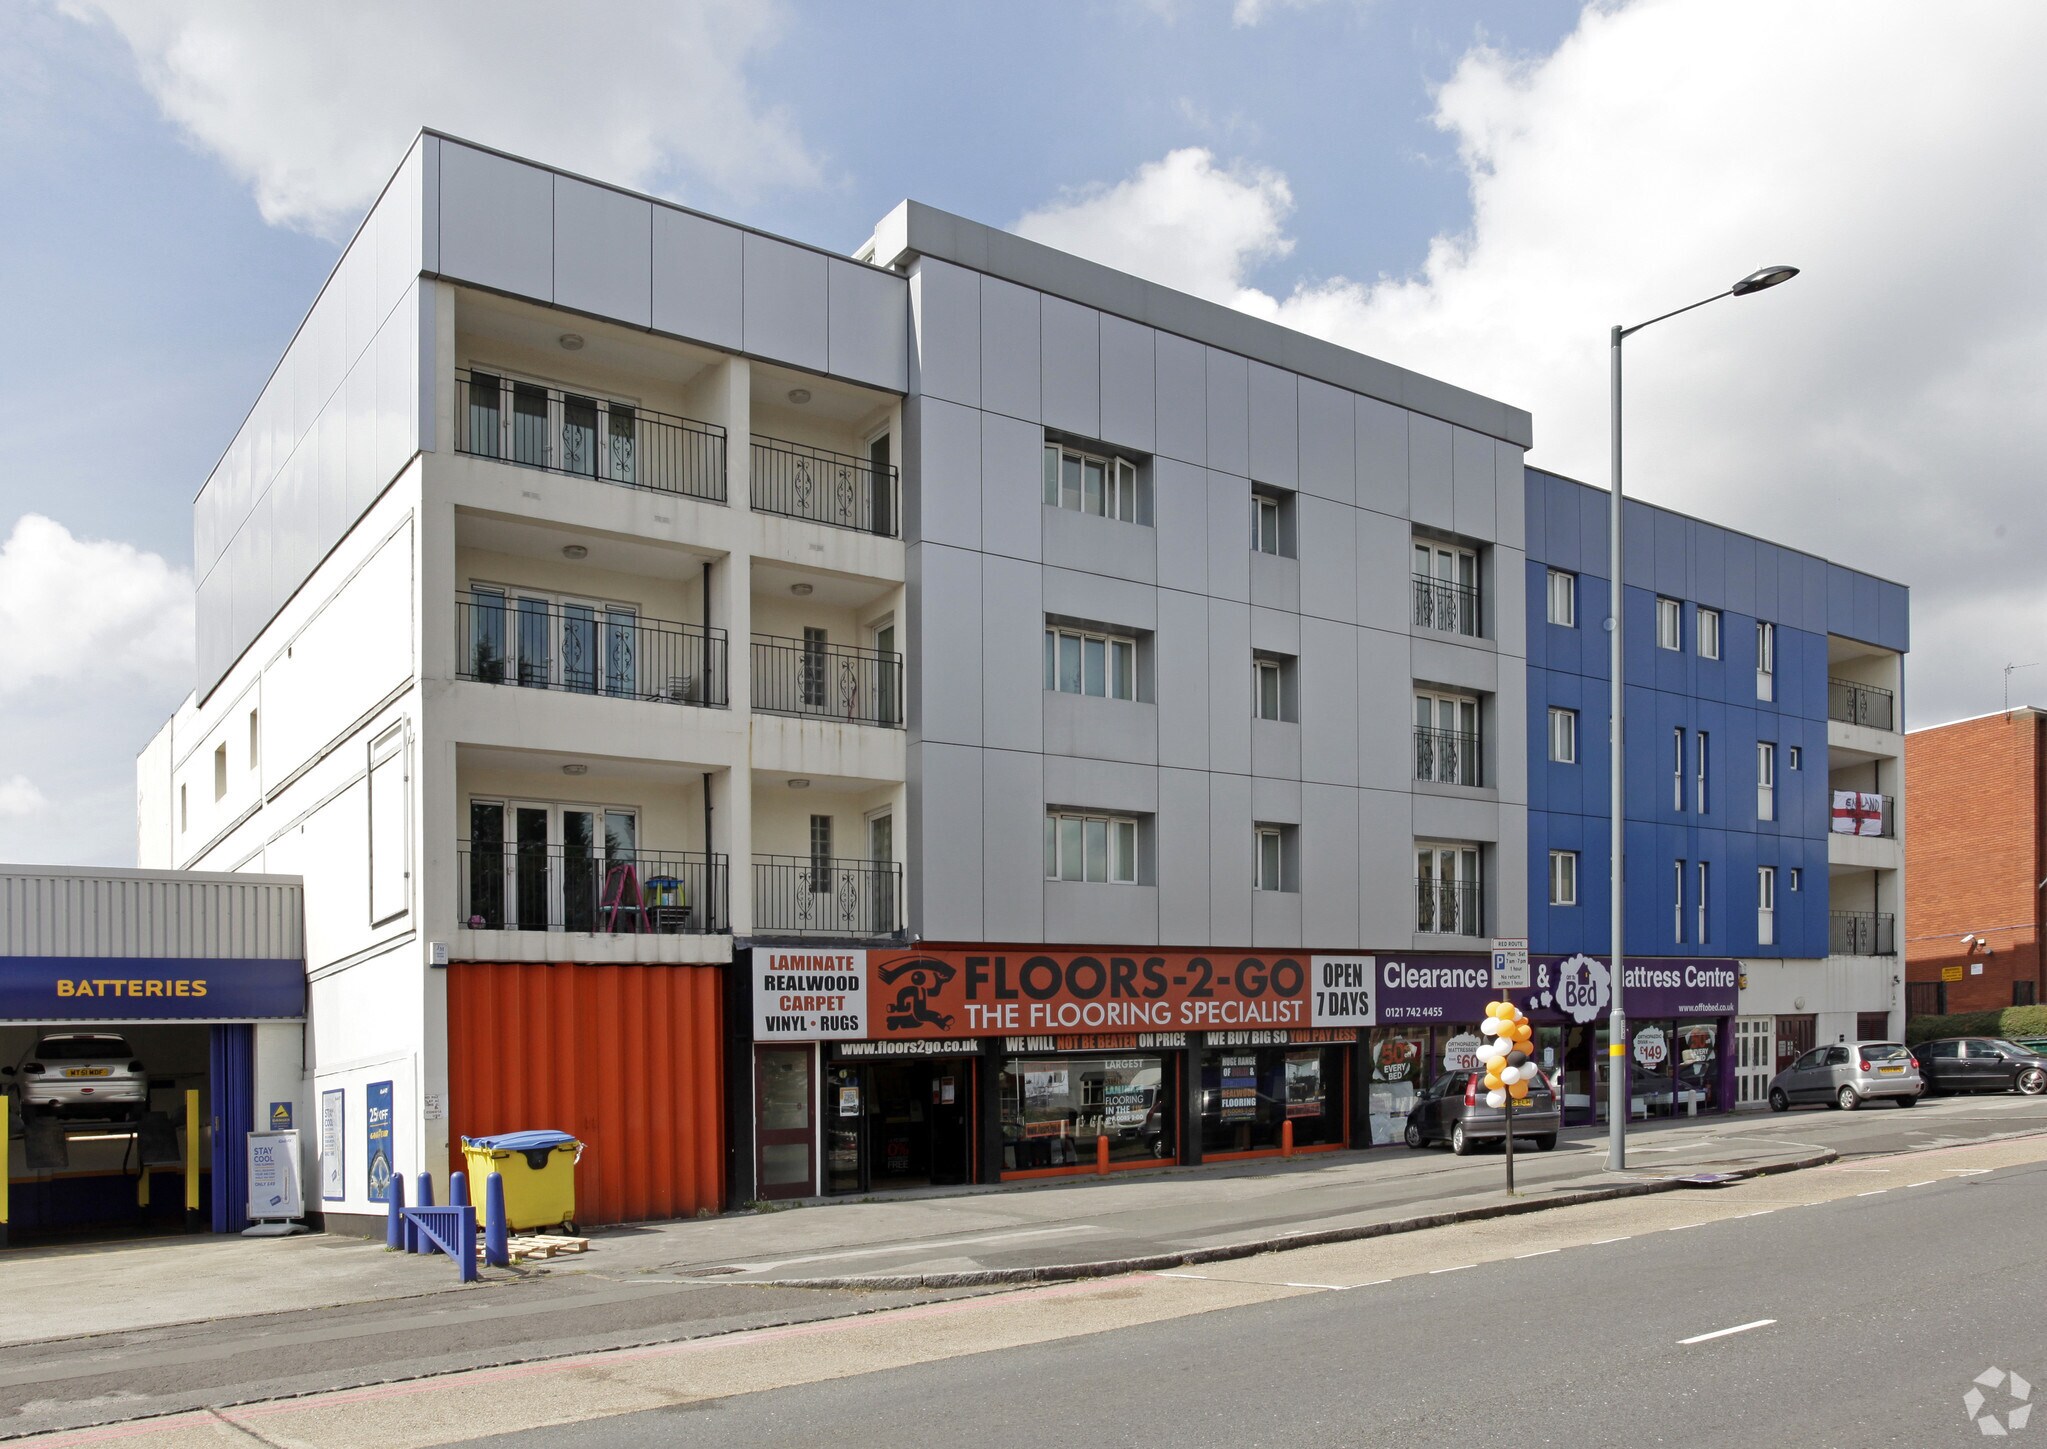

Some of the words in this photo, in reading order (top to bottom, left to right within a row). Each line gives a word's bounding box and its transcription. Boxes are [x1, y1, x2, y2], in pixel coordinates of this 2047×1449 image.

[769, 955, 854, 971] LAMINATE
[1496, 955, 1504, 969] P
[965, 956, 1304, 1000] FLOORS-2-GO
[1322, 962, 1363, 988] OPEN
[1383, 961, 1489, 988] Clearance
[1537, 963, 1550, 988] &
[1610, 965, 1681, 987] attress
[1685, 965, 1735, 987] Centre
[57, 979, 207, 997] BATTERIES
[764, 975, 859, 991] REALWOOD
[1566, 980, 1597, 1007] Bed
[779, 995, 845, 1012] CARPET
[1316, 992, 1326, 1017] 7
[1328, 991, 1369, 1016] DAYS
[1678, 1002, 1735, 1012] www.offtobed.co.uk
[964, 1003, 1019, 1029] THE
[1030, 1002, 1172, 1028] FLOORING
[1180, 1000, 1303, 1024] SPECIALIST
[1385, 1007, 1404, 1017] 0121
[1406, 1007, 1421, 1017] 742
[1422, 1007, 1443, 1017] 4455
[765, 1015, 807, 1032] VINYL
[820, 1015, 859, 1032] RUGS
[1005, 1036, 1025, 1052] WE
[1026, 1036, 1055, 1051] WILL
[1057, 1035, 1080, 1049] NOT
[1081, 1035, 1095, 1049] BE
[1097, 1034, 1136, 1049] BEATEN
[1138, 1033, 1154, 1048] ON
[1155, 1032, 1186, 1047] PRICE
[1207, 1031, 1225, 1045] WE
[1227, 1031, 1249, 1044] BUY
[1252, 1030, 1271, 1044] BIG
[1272, 1030, 1288, 1043] SO
[1289, 1030, 1310, 1042] YOU
[1312, 1029, 1331, 1042] PAY
[1333, 1028, 1357, 1041] LESS
[840, 1039, 978, 1055] www.floors2go.co.uk
[1640, 1045, 1662, 1060] £149
[1105, 1059, 1143, 1069] LARGEST
[1222, 1057, 1237, 1067] HUGE
[1237, 1056, 1256, 1066] RANGE
[1383, 1063, 1406, 1073] EVERY
[1223, 1067, 1231, 1077] OF
[1249, 1067, 1255, 1076] &
[1388, 1072, 1402, 1080] BED
[1105, 1095, 1144, 1105] FLOORING
[1222, 1097, 1256, 1107] FLOORING
[1105, 1106, 1115, 1115] IN
[1116, 1105, 1130, 1114] THE
[254, 1147, 273, 1155] STAY
